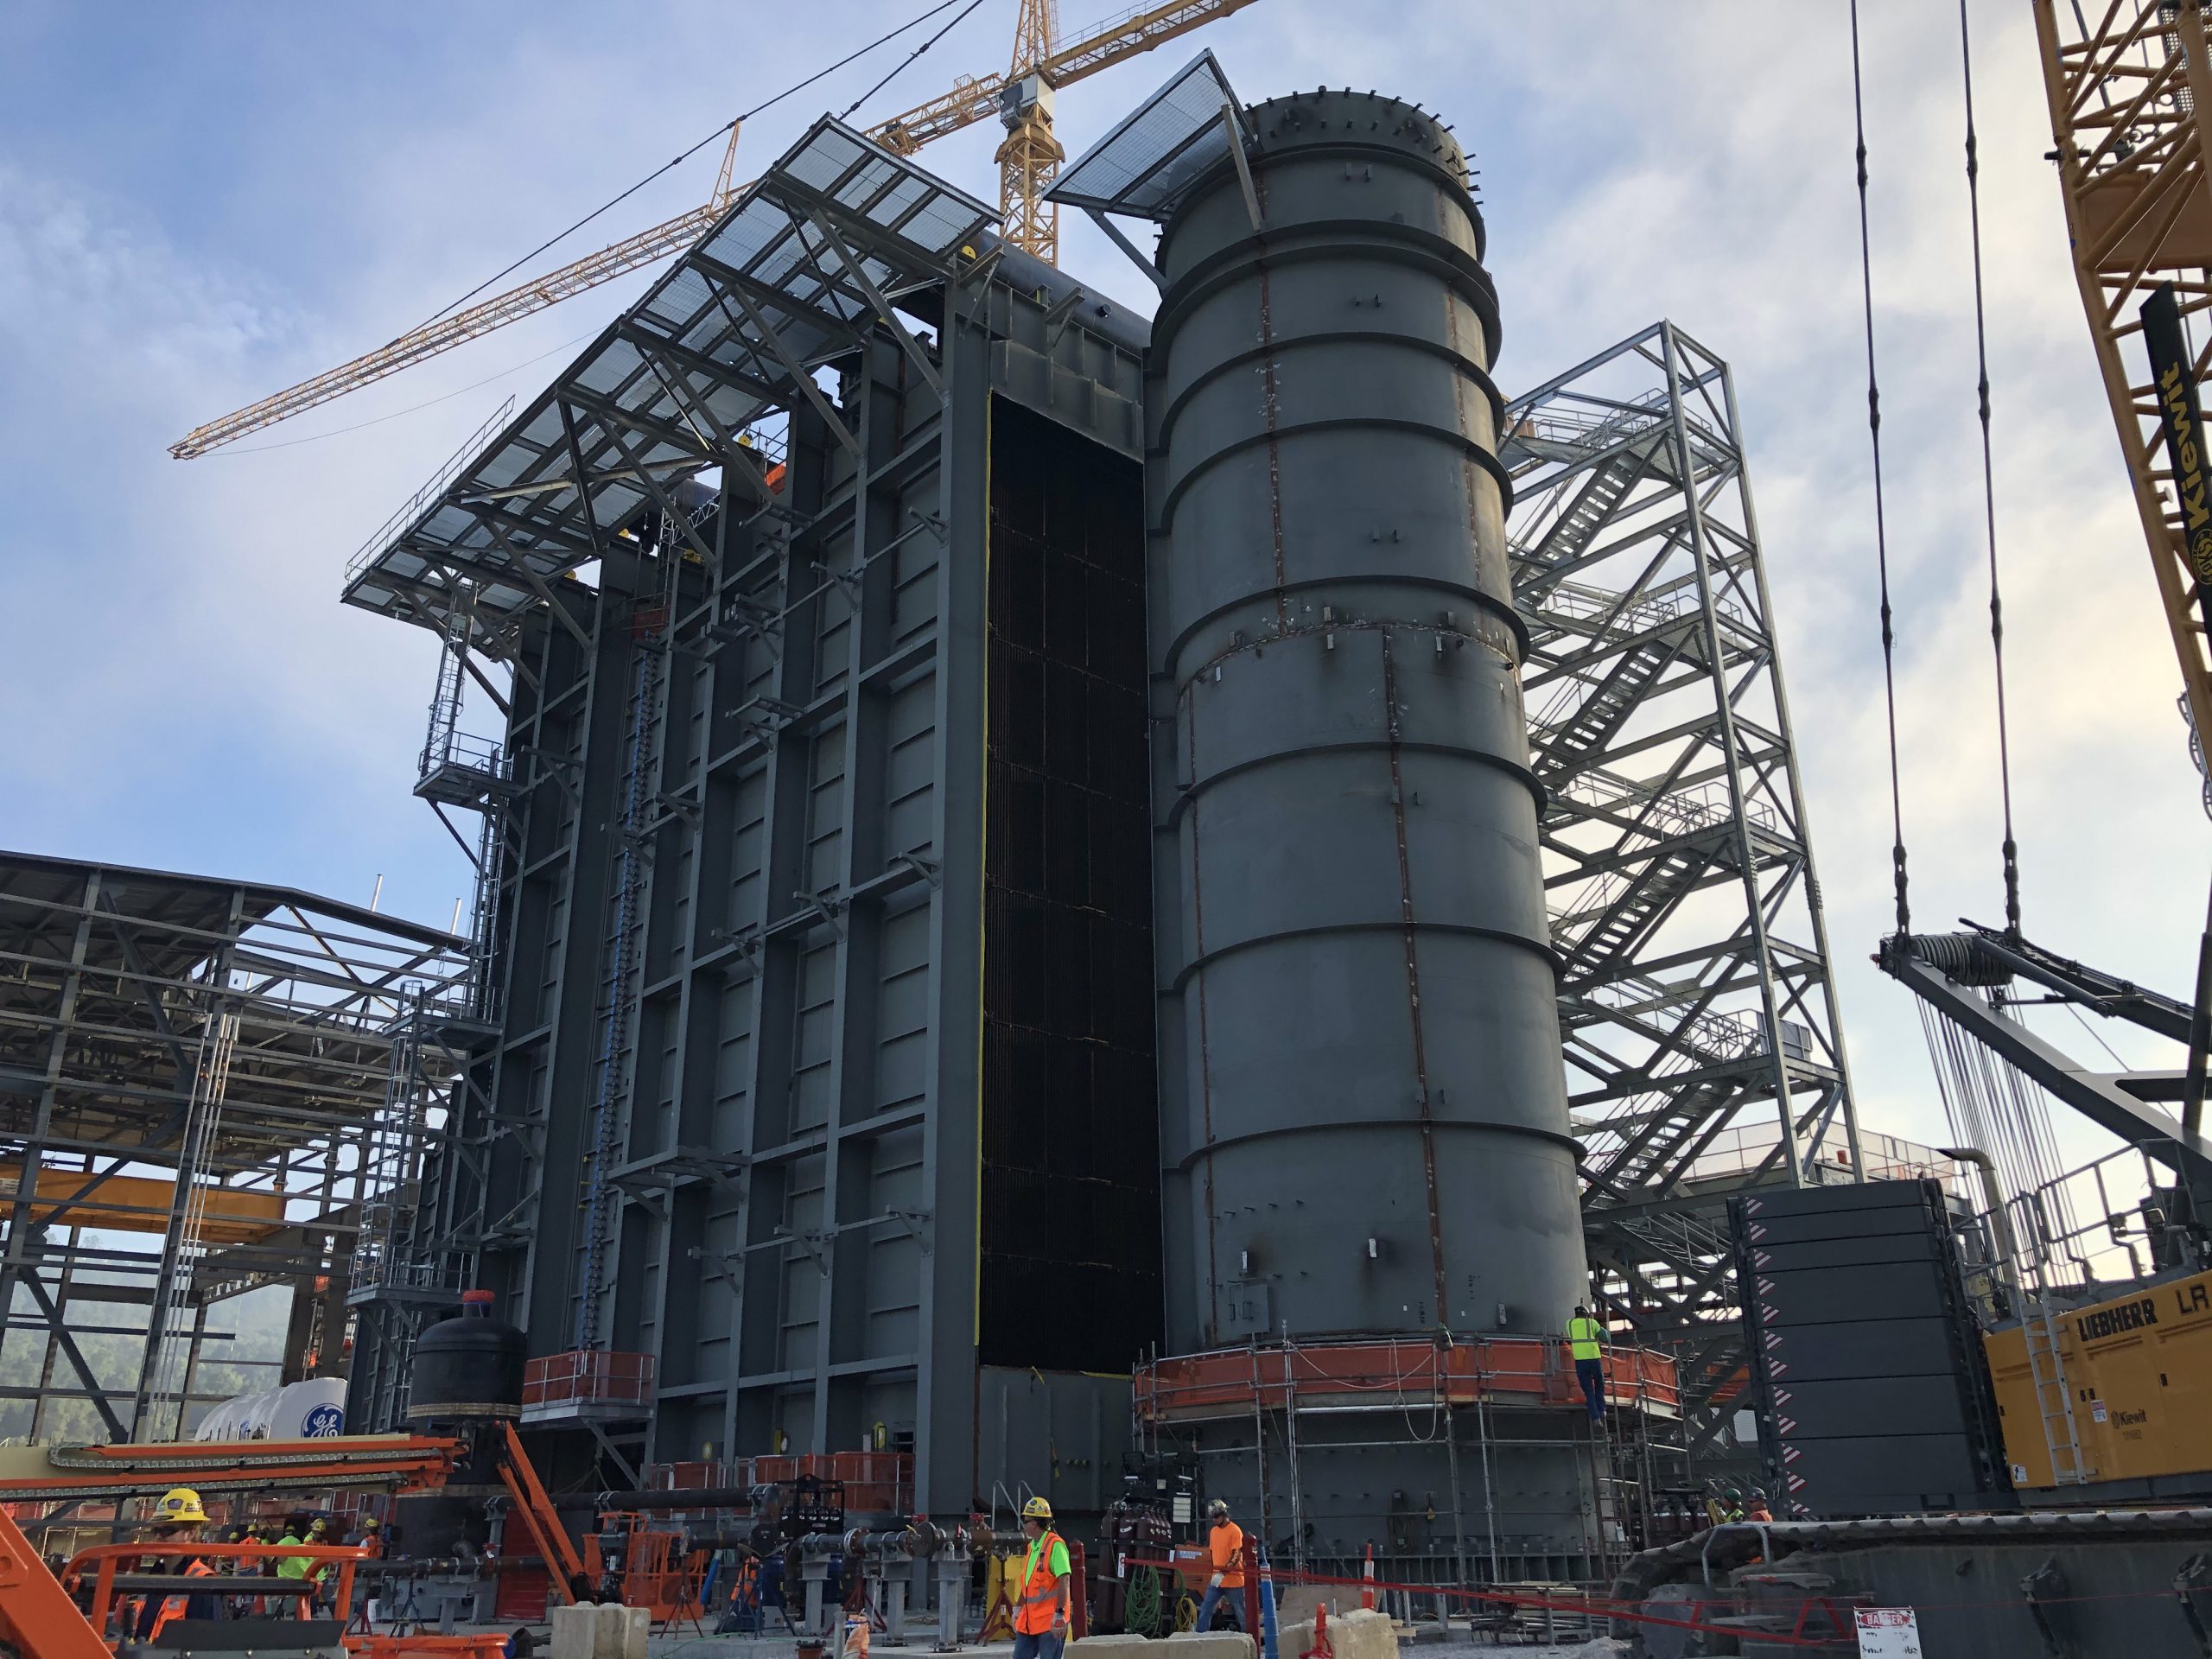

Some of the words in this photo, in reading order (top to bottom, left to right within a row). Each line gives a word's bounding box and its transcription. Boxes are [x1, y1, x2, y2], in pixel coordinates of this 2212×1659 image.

[2161, 362, 2209, 531] Kiewit
[2077, 1299, 2158, 1341] LIEBHERR
[2176, 1284, 2209, 1314] LR
[2120, 1408, 2147, 1426] Kiewit
[1867, 1614, 1903, 1625] DAER
